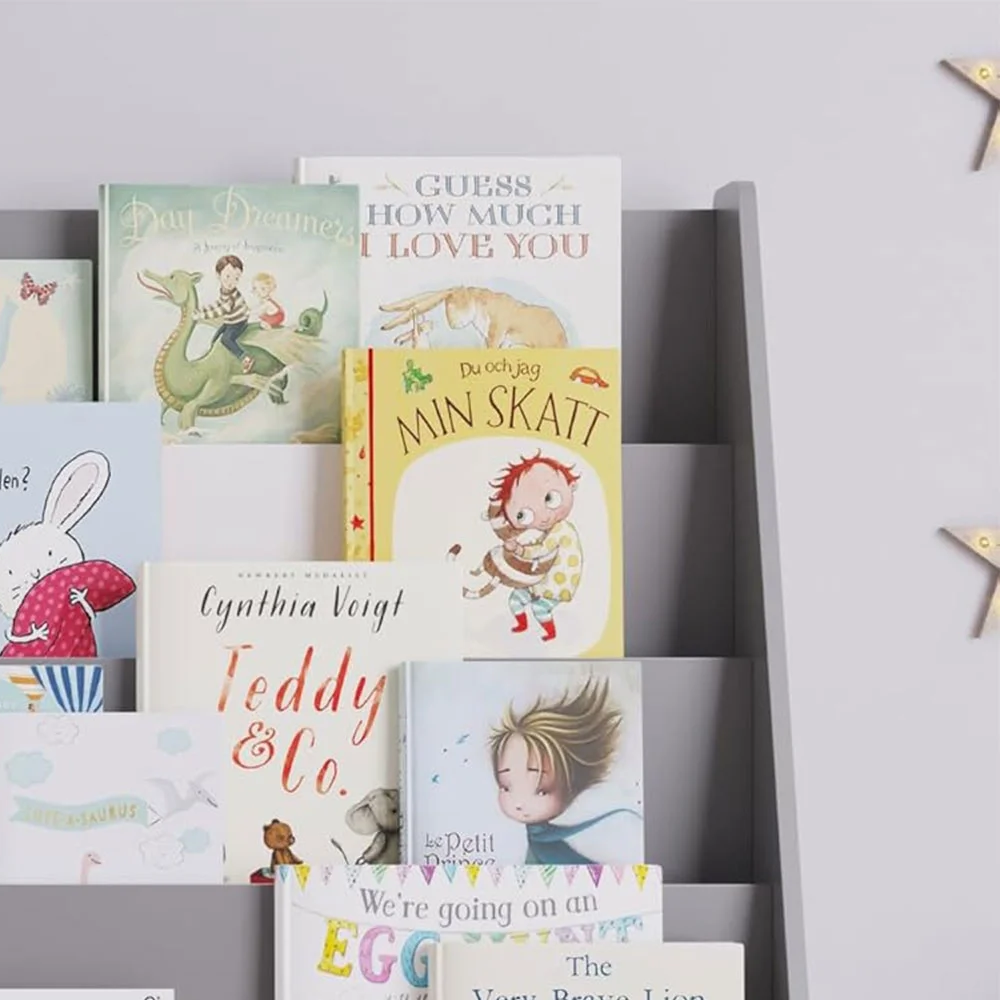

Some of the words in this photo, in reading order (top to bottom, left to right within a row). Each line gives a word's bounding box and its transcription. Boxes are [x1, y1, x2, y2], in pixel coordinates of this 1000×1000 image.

[415, 173, 532, 198] GUESS
[119, 193, 195, 249] Day
[366, 203, 455, 227] HOW
[467, 203, 582, 227] MUCH
[360, 232, 371, 259] I
[387, 232, 494, 260] LOVE
[504, 232, 590, 260] YOU
[460, 362, 482, 379] Du
[484, 358, 512, 374] och
[511, 361, 541, 382] jag
[396, 391, 474, 456] MIN
[486, 385, 610, 447] SKATT
[200, 584, 316, 633] Cynthia
[333, 584, 404, 633] Voigt
[217, 644, 387, 746] Teddy
[232, 721, 276, 769] &
[281, 727, 348, 795] Co.
[444, 832, 494, 857] Petit
[359, 888, 430, 919] We're
[438, 897, 512, 928] going
[522, 896, 559, 918] on
[565, 892, 598, 915] an
[317, 918, 441, 988] EGG
[566, 955, 612, 977] The
